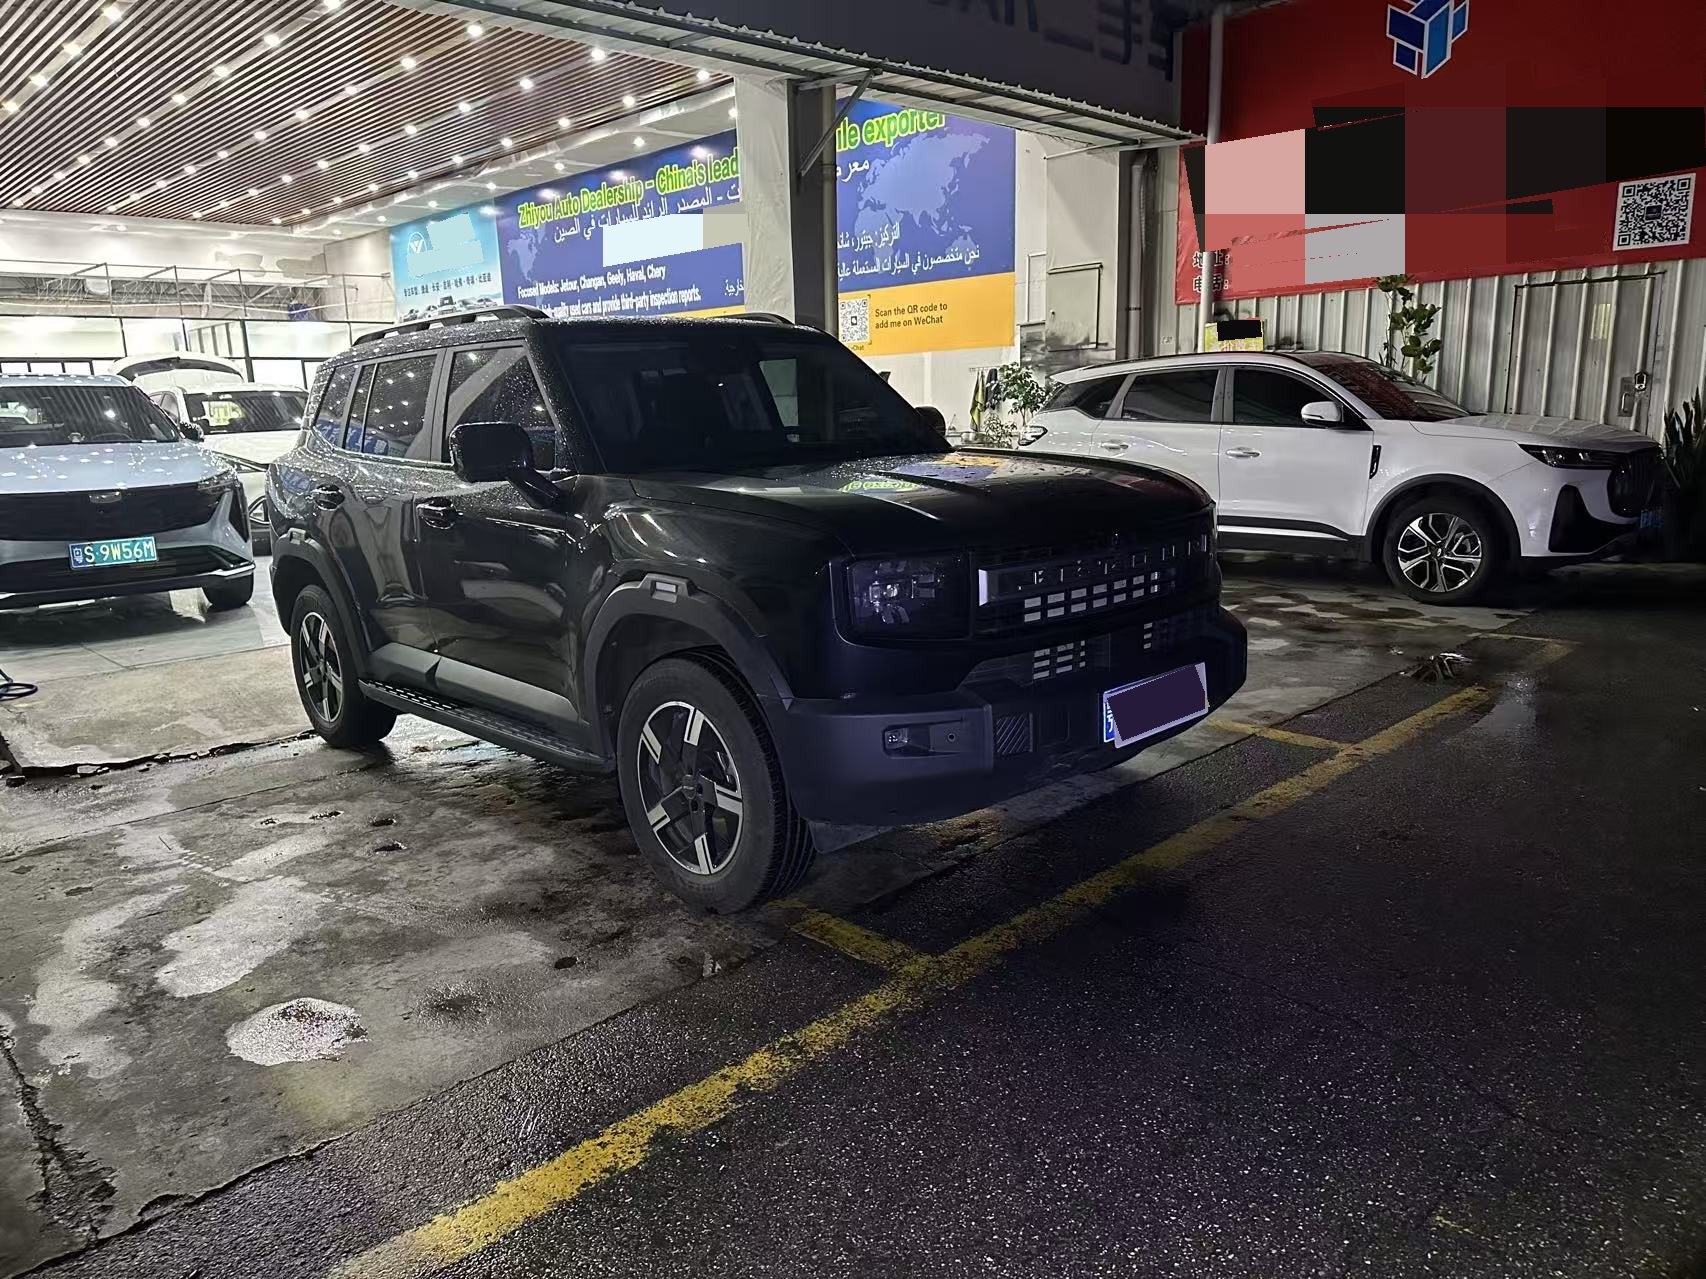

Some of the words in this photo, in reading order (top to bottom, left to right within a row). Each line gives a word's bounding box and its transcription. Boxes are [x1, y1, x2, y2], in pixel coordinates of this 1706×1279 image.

[862, 109, 945, 147] exporter
[518, 202, 553, 229] Zhiyou
[553, 195, 581, 220] Auto
[580, 176, 645, 212] Dealership
[656, 158, 706, 195] China's
[707, 147, 739, 184] lead
[553, 216, 581, 243] الصين
[583, 214, 596, 241] في
[882, 252, 910, 275] السيارات
[912, 251, 921, 275] في
[922, 247, 963, 270] متخصصون
[964, 245, 980, 265] نحن
[518, 283, 539, 299] Focused
[539, 281, 559, 297] Models:
[580, 275, 606, 291] Changan,
[606, 271, 626, 288] Geely,
[626, 266, 647, 284] Haval,
[647, 264, 666, 281] Chery
[570, 299, 581, 316] used
[582, 302, 592, 315] cars
[592, 296, 602, 314] and
[602, 293, 621, 317] provide
[620, 291, 649, 313] third-party
[649, 287, 678, 310] inspection
[678, 284, 702, 306] reports.
[875, 308, 892, 318] Scan
[893, 306, 905, 316] the
[907, 304, 918, 314] QR
[920, 303, 938, 313] code
[940, 303, 948, 311] to
[875, 320, 888, 329] add
[890, 320, 901, 328] me
[914, 315, 943, 326] WeChat
